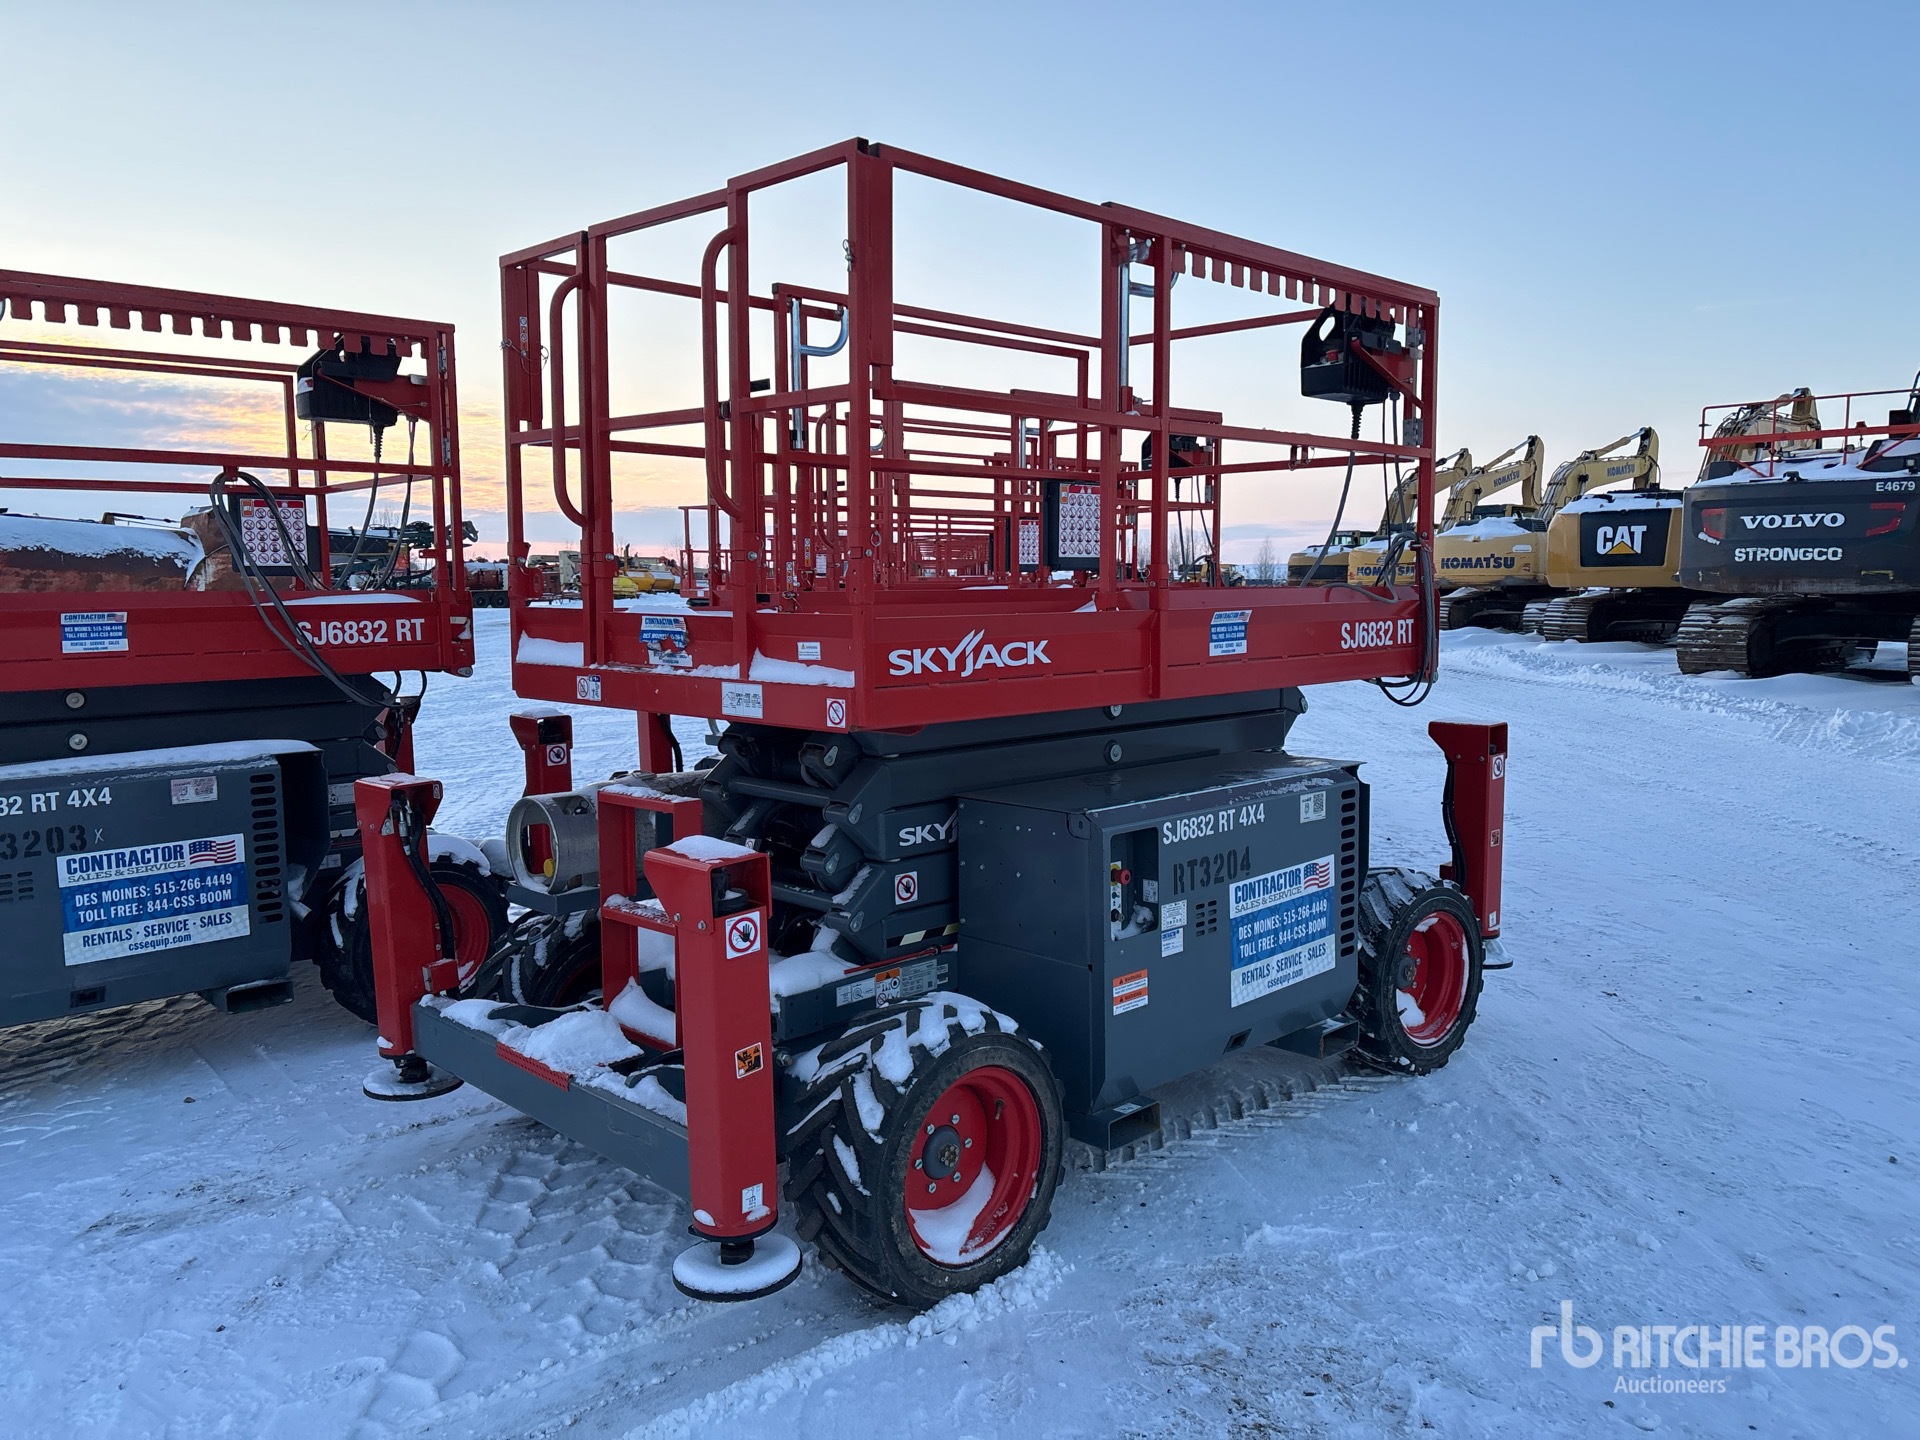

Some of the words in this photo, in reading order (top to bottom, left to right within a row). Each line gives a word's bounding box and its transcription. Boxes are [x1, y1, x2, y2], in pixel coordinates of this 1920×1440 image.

[1494, 470, 1520, 487] KOMATSU
[1607, 462, 1636, 477] KOMATSU
[1876, 481, 1916, 492] E4679
[1740, 512, 1846, 529] VOLVO
[1596, 525, 1647, 555] CAT
[1734, 547, 1843, 562] STRONGCO
[1356, 566, 1415, 577] KOMSU
[1440, 554, 1516, 570] KOMATSU
[296, 620, 389, 646] SJ6832
[395, 618, 425, 641] RT
[1341, 620, 1393, 649] SJ6832
[1397, 618, 1414, 644] RT
[888, 629, 1052, 677] SKYJACK
[31, 792, 60, 813] RT
[67, 787, 112, 808] 4X4
[899, 809, 958, 846] SKYJ
[1162, 813, 1215, 845] SJ6832
[1218, 809, 1235, 833] RT
[1239, 803, 1266, 827] 4X4
[66, 844, 185, 875] CONTRACTOR
[68, 870, 114, 883] SALES
[127, 860, 186, 875] SERVICE
[1173, 846, 1251, 895] RT3204
[75, 892, 98, 907] DES
[102, 886, 150, 903] MOINES:
[154, 873, 233, 895] 515-266-4449
[1234, 867, 1301, 905] CONTRACTOR
[1235, 901, 1261, 914] SALES
[1268, 888, 1301, 903] SERVICE
[78, 907, 108, 923] TOLL
[111, 904, 144, 919] FREE:
[147, 889, 232, 913] 844-CSS-BOOM
[1238, 925, 1252, 940] DES
[1254, 914, 1282, 935] MOINES:
[1283, 899, 1328, 926] 515-266-4449
[82, 928, 133, 948] RENTALS
[143, 919, 190, 938] SERVICE
[200, 912, 233, 928] SALES
[128, 933, 192, 951] cssequip.com
[1240, 941, 1256, 958] TOLL
[1258, 937, 1277, 951] FREE:
[1278, 917, 1327, 945] 844-CSS-BOOM
[1241, 965, 1270, 986] RENTALS
[1276, 952, 1302, 973] SERVICE
[1307, 943, 1326, 961] SALES
[1267, 967, 1303, 989] cssequip.com
